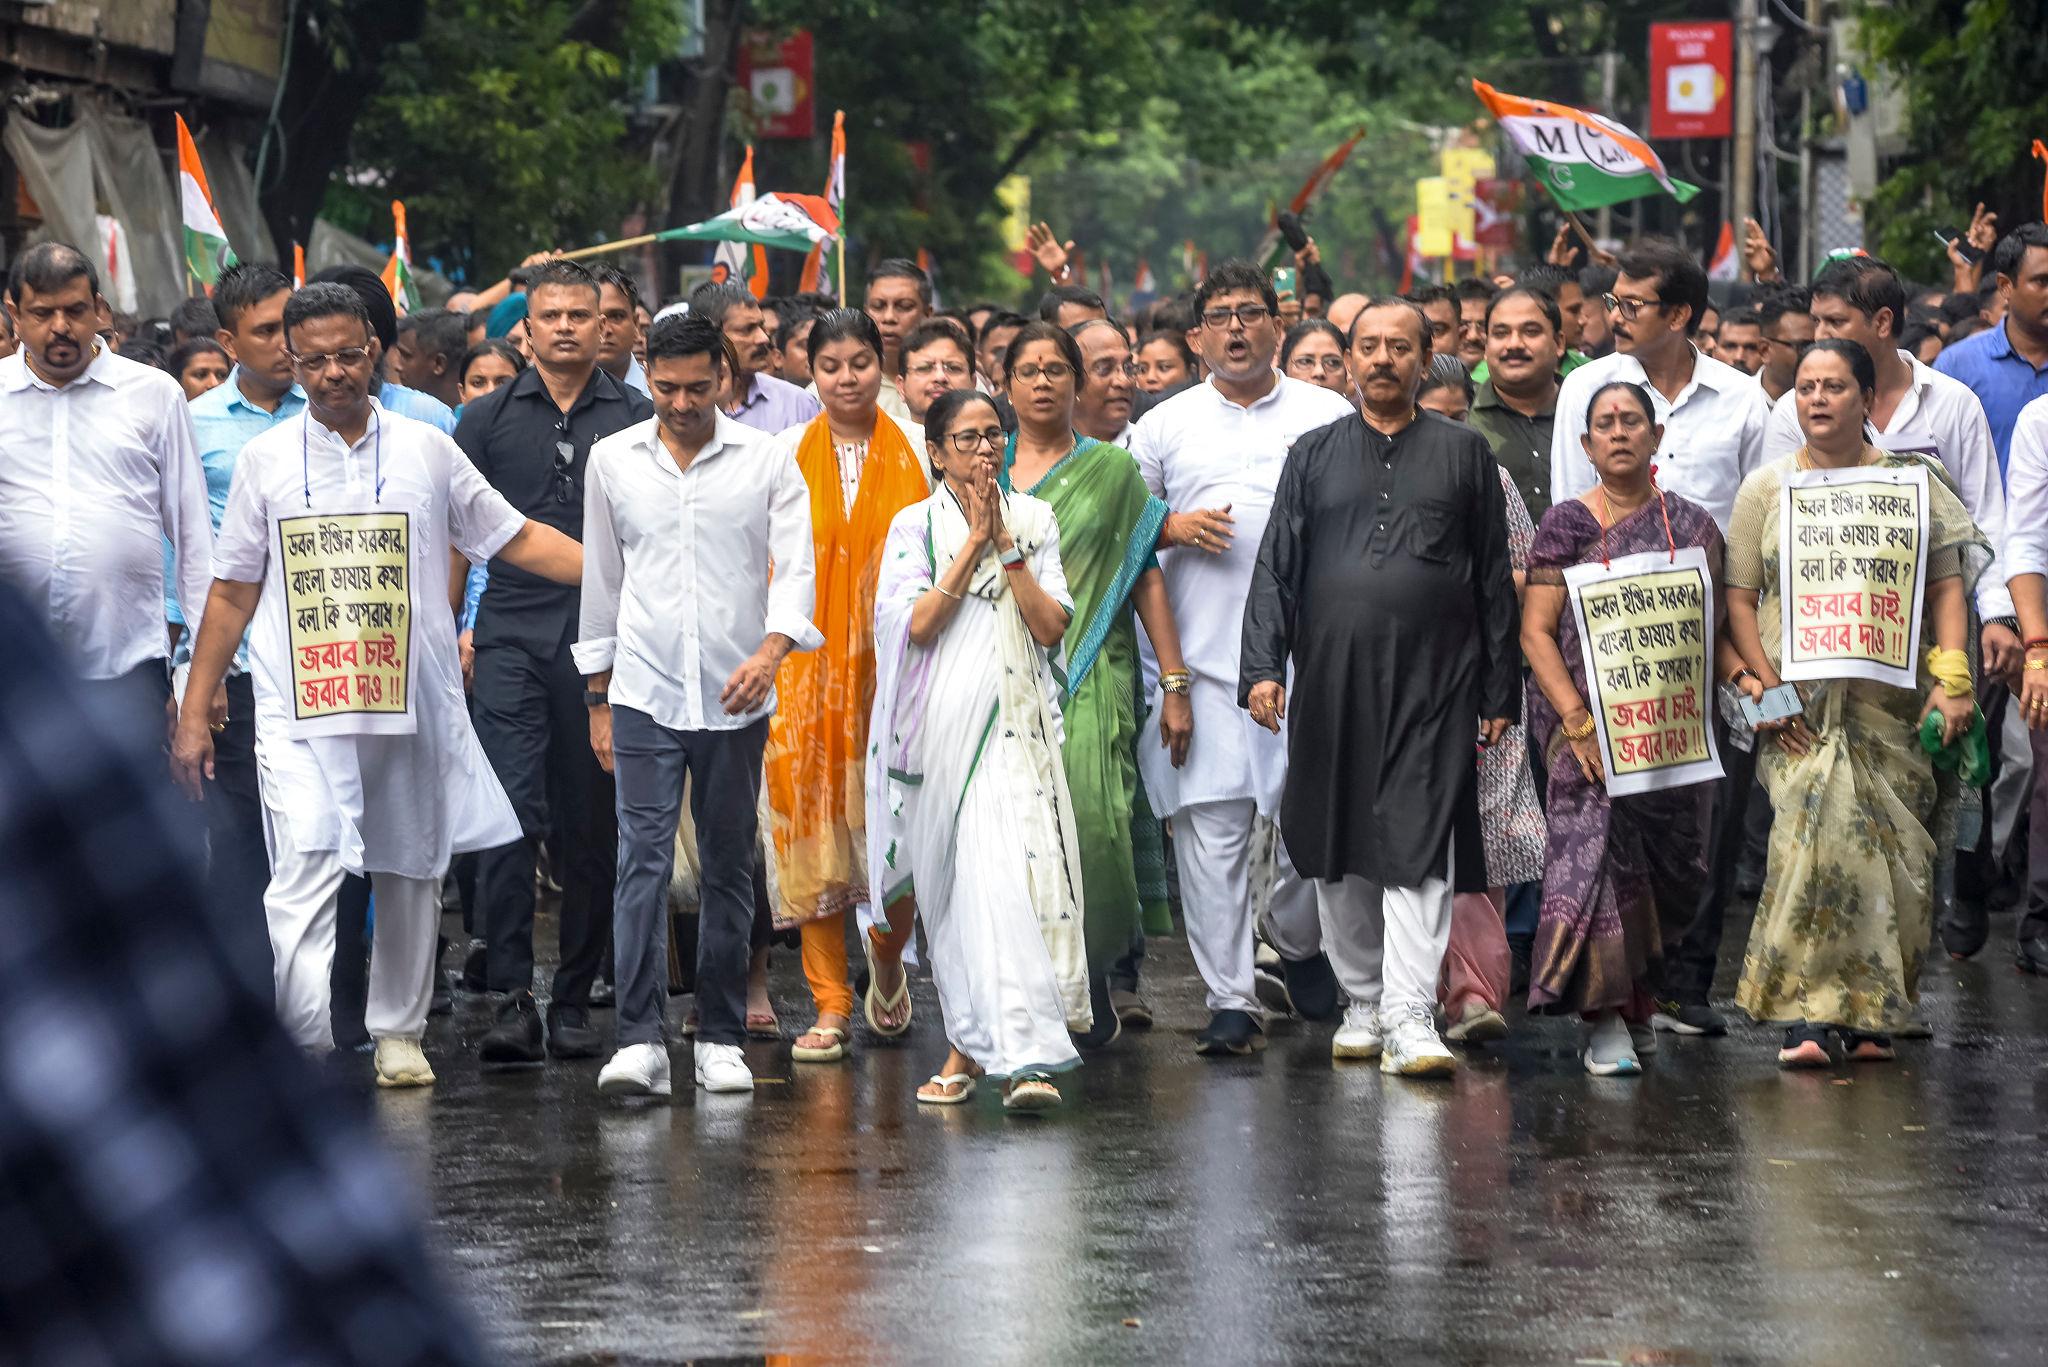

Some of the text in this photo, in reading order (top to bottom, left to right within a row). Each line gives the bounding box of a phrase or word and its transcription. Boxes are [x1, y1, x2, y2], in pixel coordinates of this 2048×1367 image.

[1532, 125, 1569, 154] M
[1549, 163, 1576, 190] C
[1797, 498, 1826, 517] ডবল
[286, 532, 317, 557] ডবল
[1797, 525, 1913, 550] বাংলা ভাষায় কথা
[291, 565, 404, 596] বাংলা ভাষায় কথা
[1800, 558, 1825, 583] বলা
[1830, 550, 1847, 581] কি
[1852, 557, 1899, 585] অপরাধ
[296, 607, 320, 633] বলা
[322, 597, 340, 630] কি
[345, 601, 393, 629] অপরাধ
[1587, 594, 1621, 619] ডবল
[1798, 592, 1862, 619] জবাব
[1596, 619, 1701, 656] বাংলা ভাষায় কথা
[1799, 624, 1852, 654] জবাব
[1858, 624, 1885, 656] দাও
[297, 641, 359, 673] জবাব
[1604, 665, 1632, 691] বলা
[1632, 655, 1651, 688] কি
[1654, 656, 1693, 684] অপরাধ
[299, 675, 350, 711] জবাব
[355, 674, 382, 708] দাও
[1609, 696, 1667, 729] জবাব
[1615, 731, 1663, 767] জবাব
[1665, 727, 1688, 761] দাও
